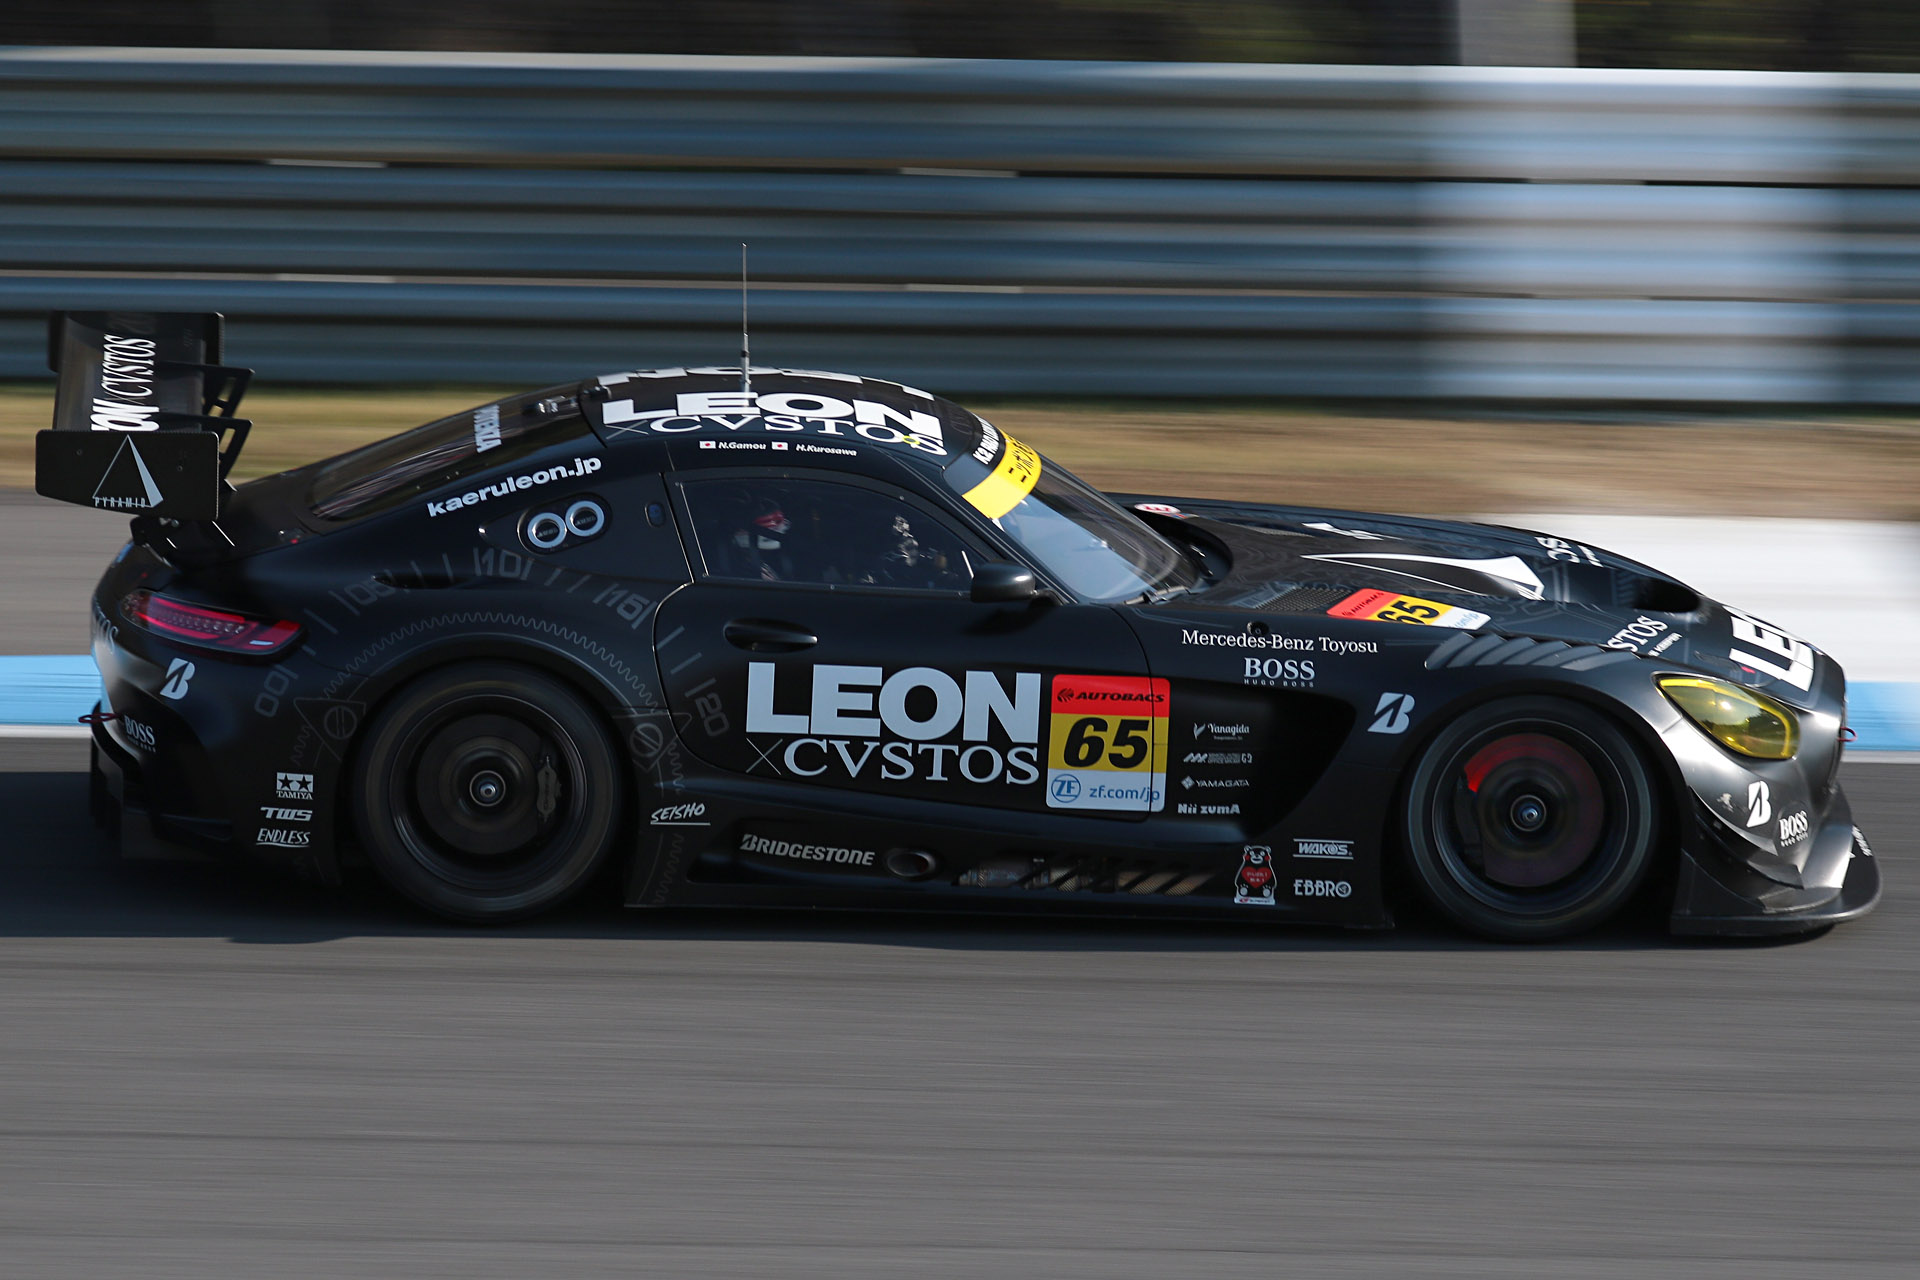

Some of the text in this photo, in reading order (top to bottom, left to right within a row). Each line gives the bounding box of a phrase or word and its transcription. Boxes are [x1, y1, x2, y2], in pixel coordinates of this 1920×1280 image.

[602, 392, 944, 440] LEON
[650, 415, 948, 456] CVSTOS
[427, 457, 601, 517] kaeruleon.jp
[1181, 629, 1378, 655] Mercedes-Benz Toyosu
[1243, 657, 1316, 681] BOSS
[1283, 680, 1314, 688] BOSS
[746, 661, 1042, 743] LEON
[1075, 691, 1165, 703] AUTOBACS
[124, 715, 156, 746] BOSS
[1207, 723, 1250, 736] Yanagida
[1063, 717, 1150, 769] 65
[784, 738, 1040, 785] CVSTOS
[276, 791, 313, 800] TAMIYA
[1089, 785, 1160, 803] zf.com/jp
[1196, 780, 1250, 788] YAMAGATA
[260, 806, 313, 822] TWS
[651, 802, 706, 823] SEISHO
[257, 828, 311, 845] ENDLESS
[1779, 810, 1808, 841] BOSS
[740, 833, 876, 867] BRIDGESTONE
